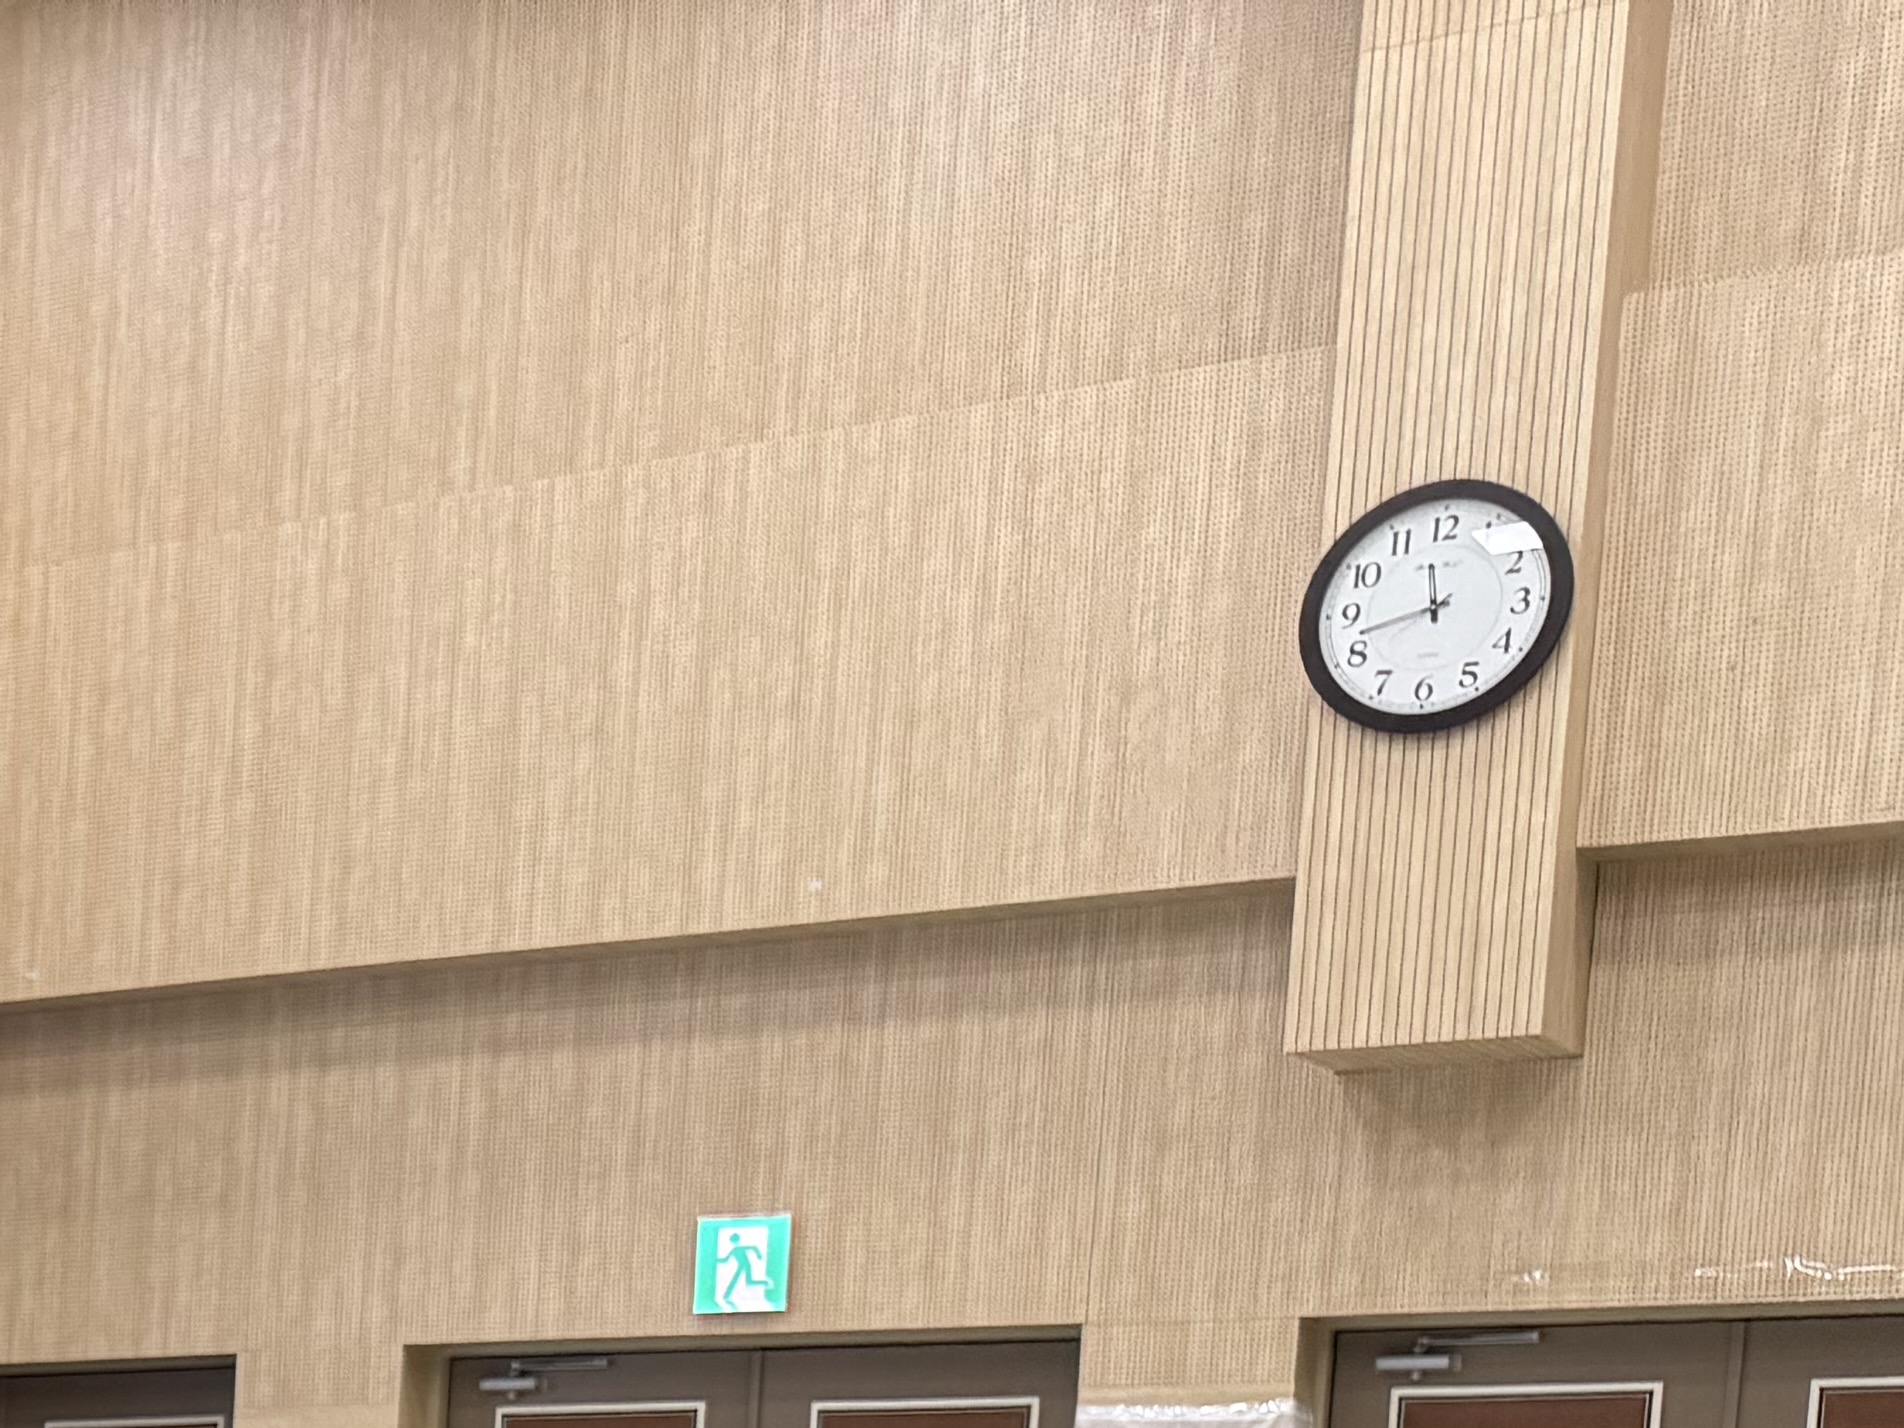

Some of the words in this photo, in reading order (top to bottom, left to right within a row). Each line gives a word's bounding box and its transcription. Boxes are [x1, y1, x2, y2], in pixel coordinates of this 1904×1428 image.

[1391, 528, 1412, 556] 11
[1432, 515, 1460, 543] 12
[1353, 561, 1382, 589] 10
[1504, 551, 1524, 575] 2
[1509, 586, 1531, 614] 3
[1341, 602, 1361, 629] 9
[1346, 640, 1368, 667] 8
[1491, 627, 1513, 654] 4
[1374, 669, 1393, 696] 7
[1414, 675, 1434, 701] 6
[1458, 661, 1480, 688] 5
